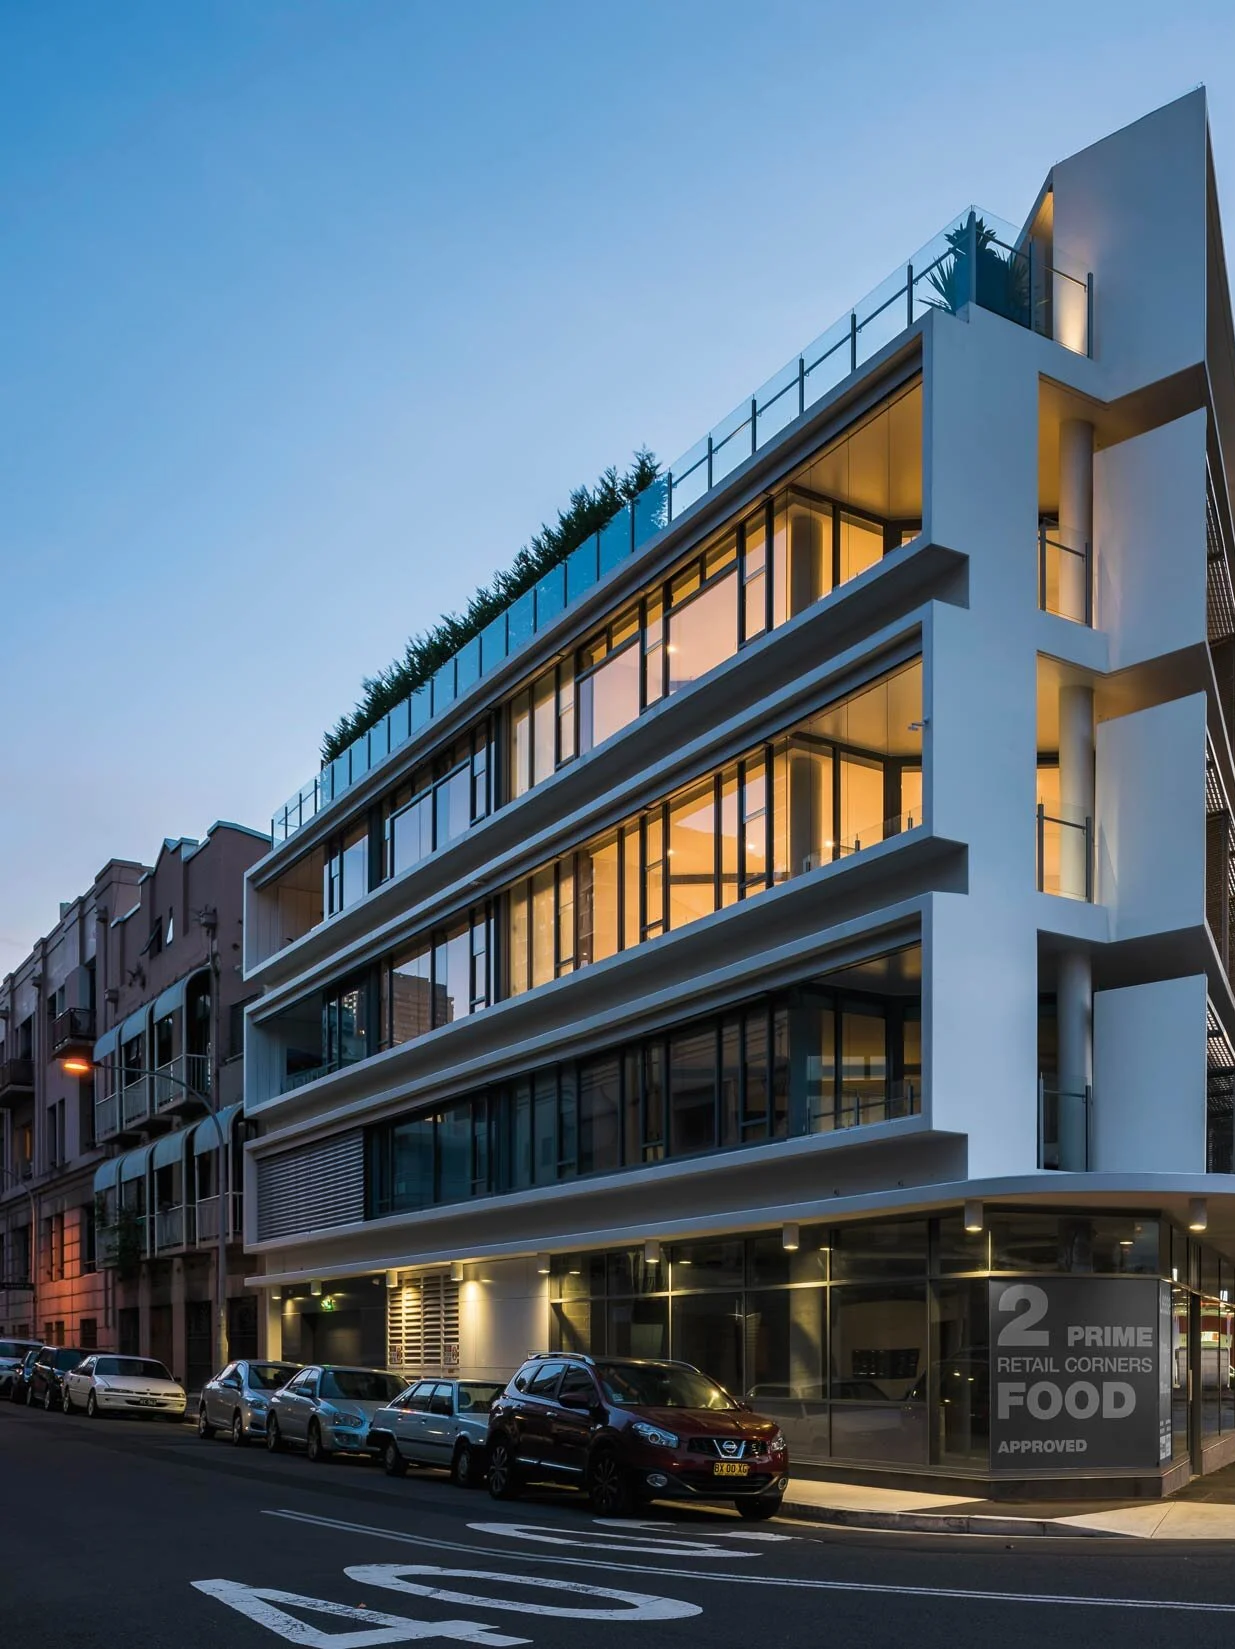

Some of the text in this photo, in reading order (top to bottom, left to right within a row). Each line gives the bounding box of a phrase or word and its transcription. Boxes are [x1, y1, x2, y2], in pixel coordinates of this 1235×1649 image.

[997, 1284, 1153, 1347] 2 PRIME
[997, 1356, 1153, 1373] RETAIL CORNERS
[997, 1380, 1137, 1420] FOOD
[997, 1439, 1088, 1454] APPROVED
[190, 1562, 704, 1649] 40
